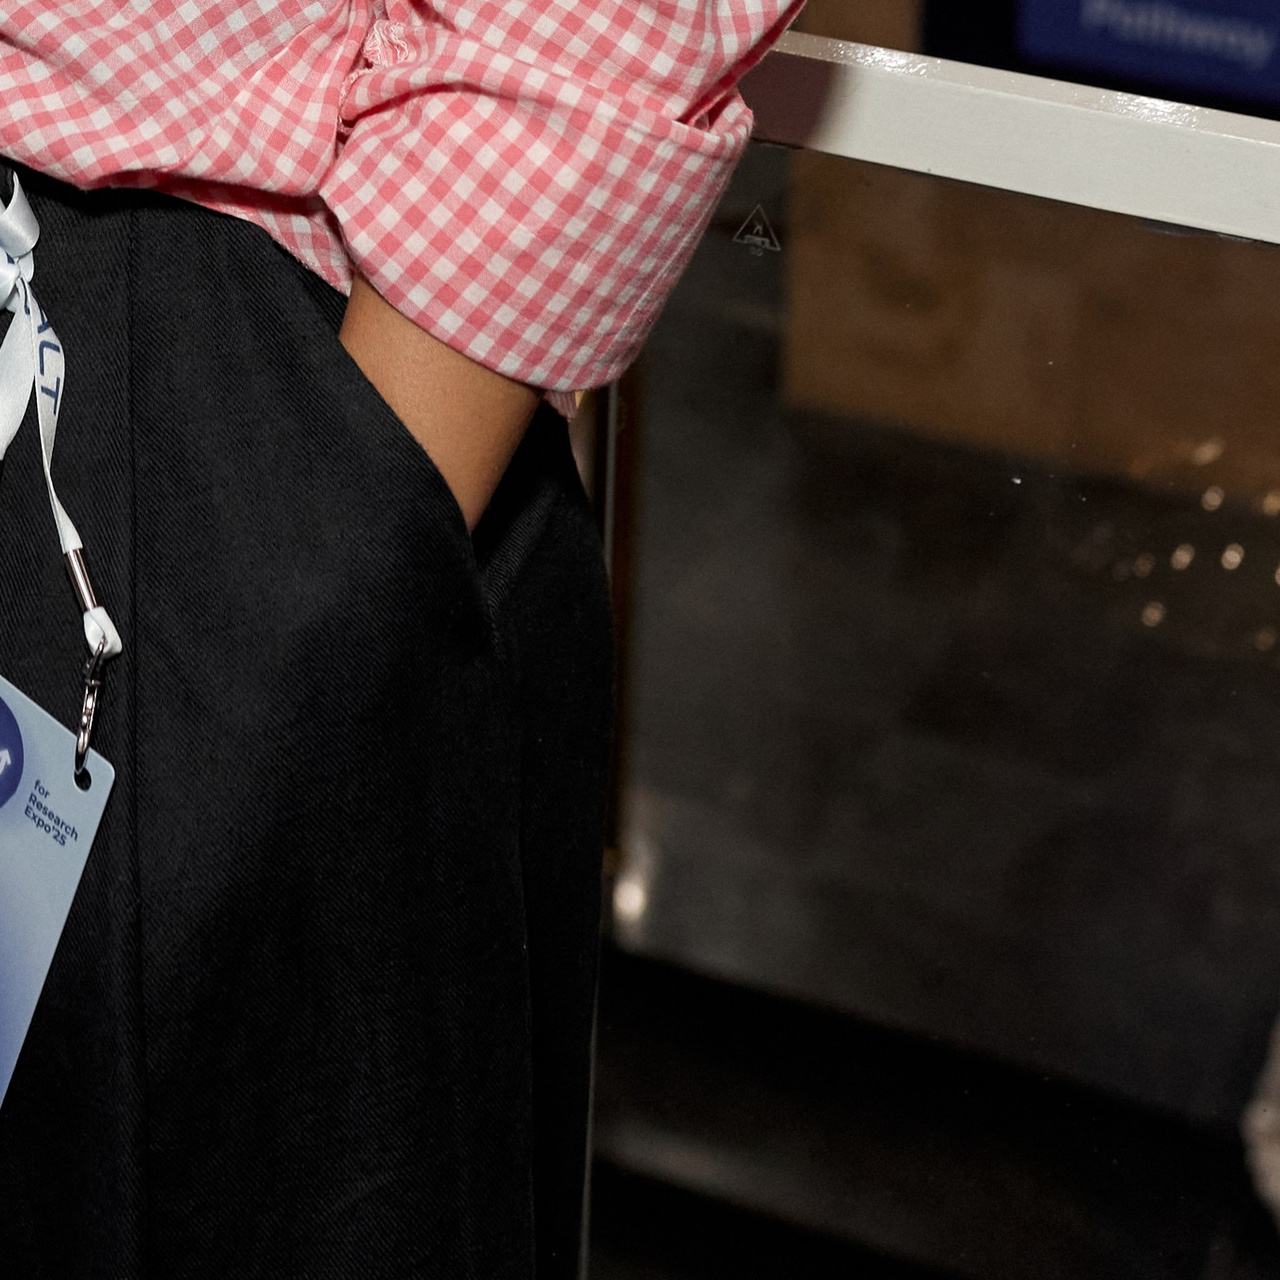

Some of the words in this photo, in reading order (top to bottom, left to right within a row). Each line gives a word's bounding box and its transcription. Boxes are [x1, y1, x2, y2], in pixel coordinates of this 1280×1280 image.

[34, 779, 50, 799] for
[24, 805, 67, 847] Expo'25
[29, 792, 78, 842] Research
